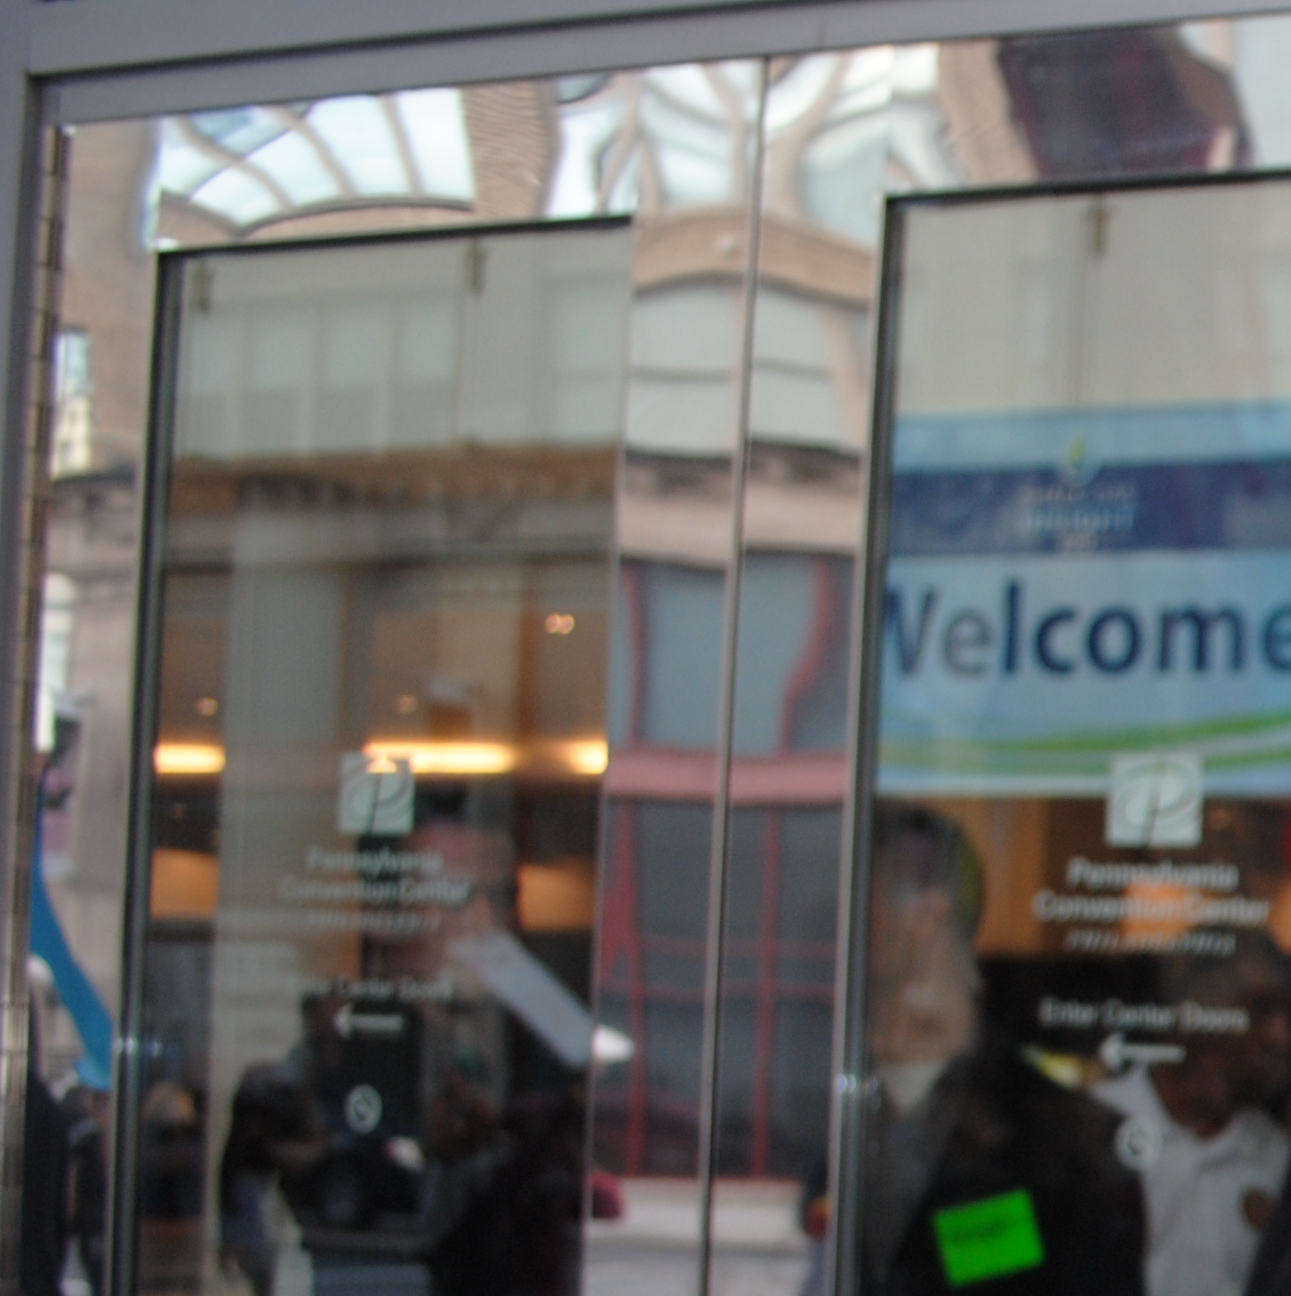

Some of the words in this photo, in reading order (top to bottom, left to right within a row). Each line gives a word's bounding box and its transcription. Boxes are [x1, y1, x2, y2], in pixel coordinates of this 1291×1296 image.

[1066, 857, 1240, 890] Pennsylvania
[1034, 890, 1185, 923] Convention
[1187, 893, 1270, 925] Center
[1101, 997, 1177, 1031] Center
